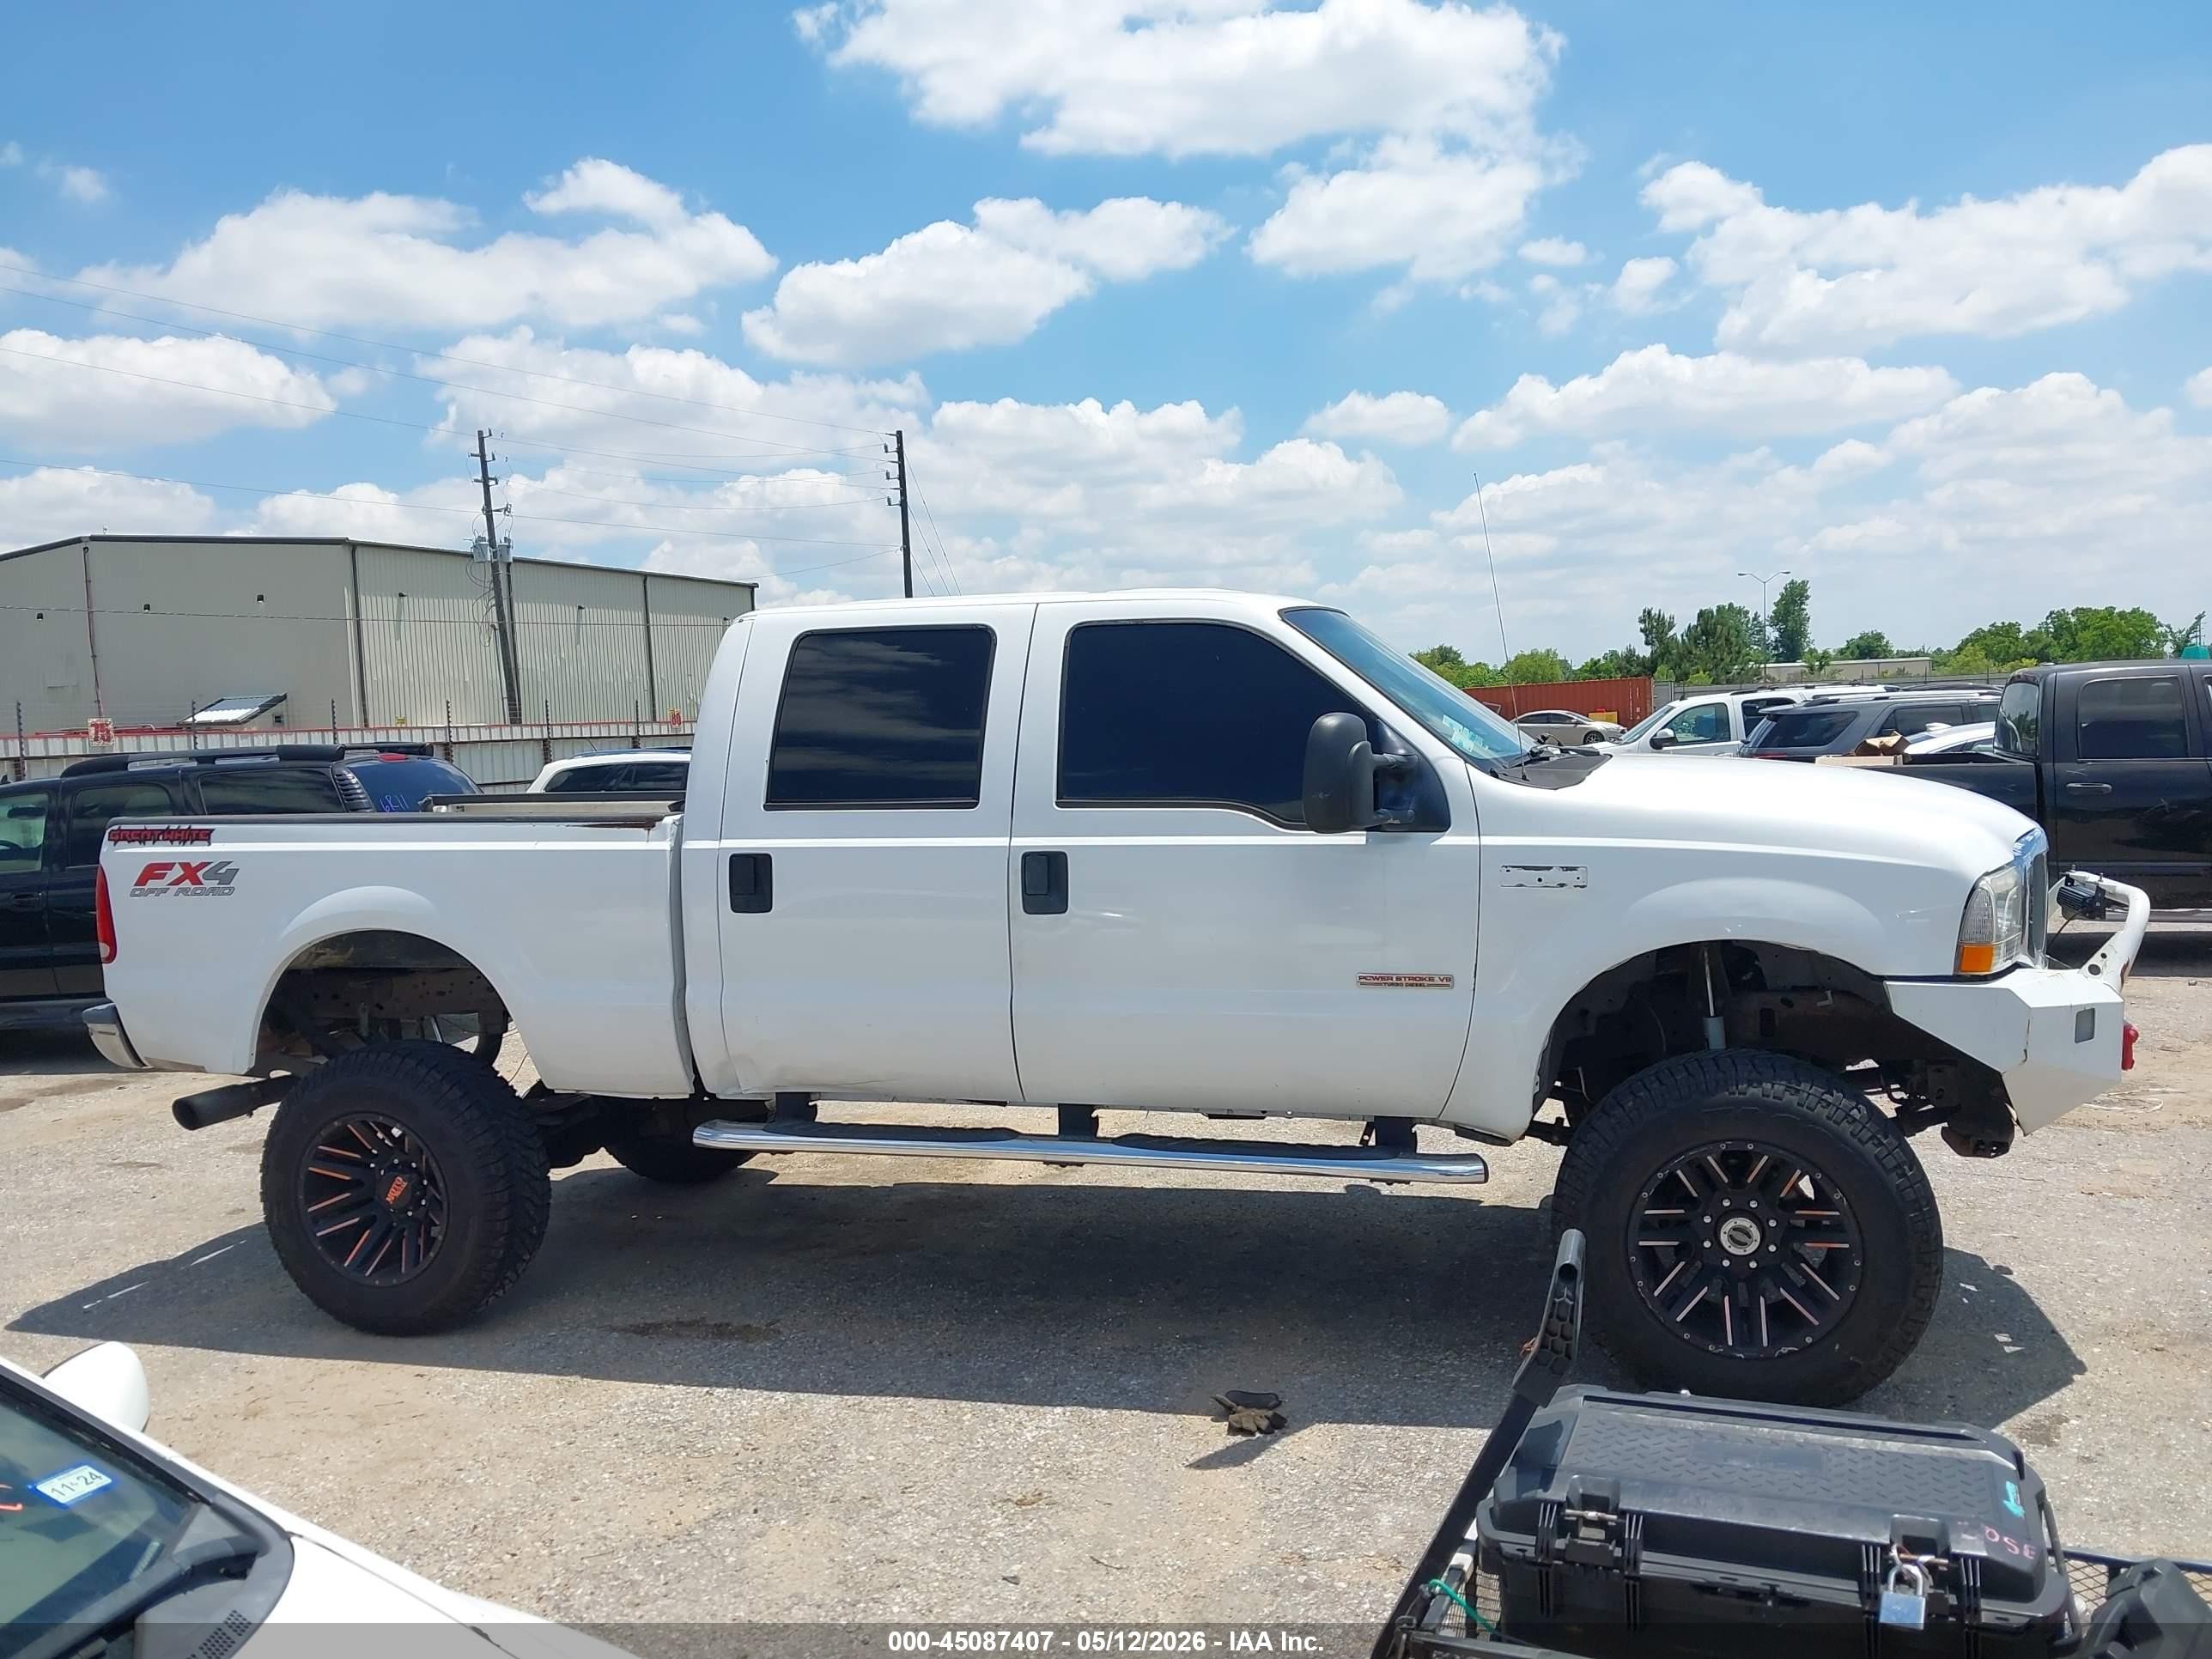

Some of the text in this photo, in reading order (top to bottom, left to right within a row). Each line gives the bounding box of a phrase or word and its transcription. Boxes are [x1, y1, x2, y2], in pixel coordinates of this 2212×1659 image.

[108, 827, 210, 843] GREAT WHITE
[133, 860, 240, 887] FX4
[129, 886, 235, 897] OFF ROAD
[77, 1471, 103, 1486] 24
